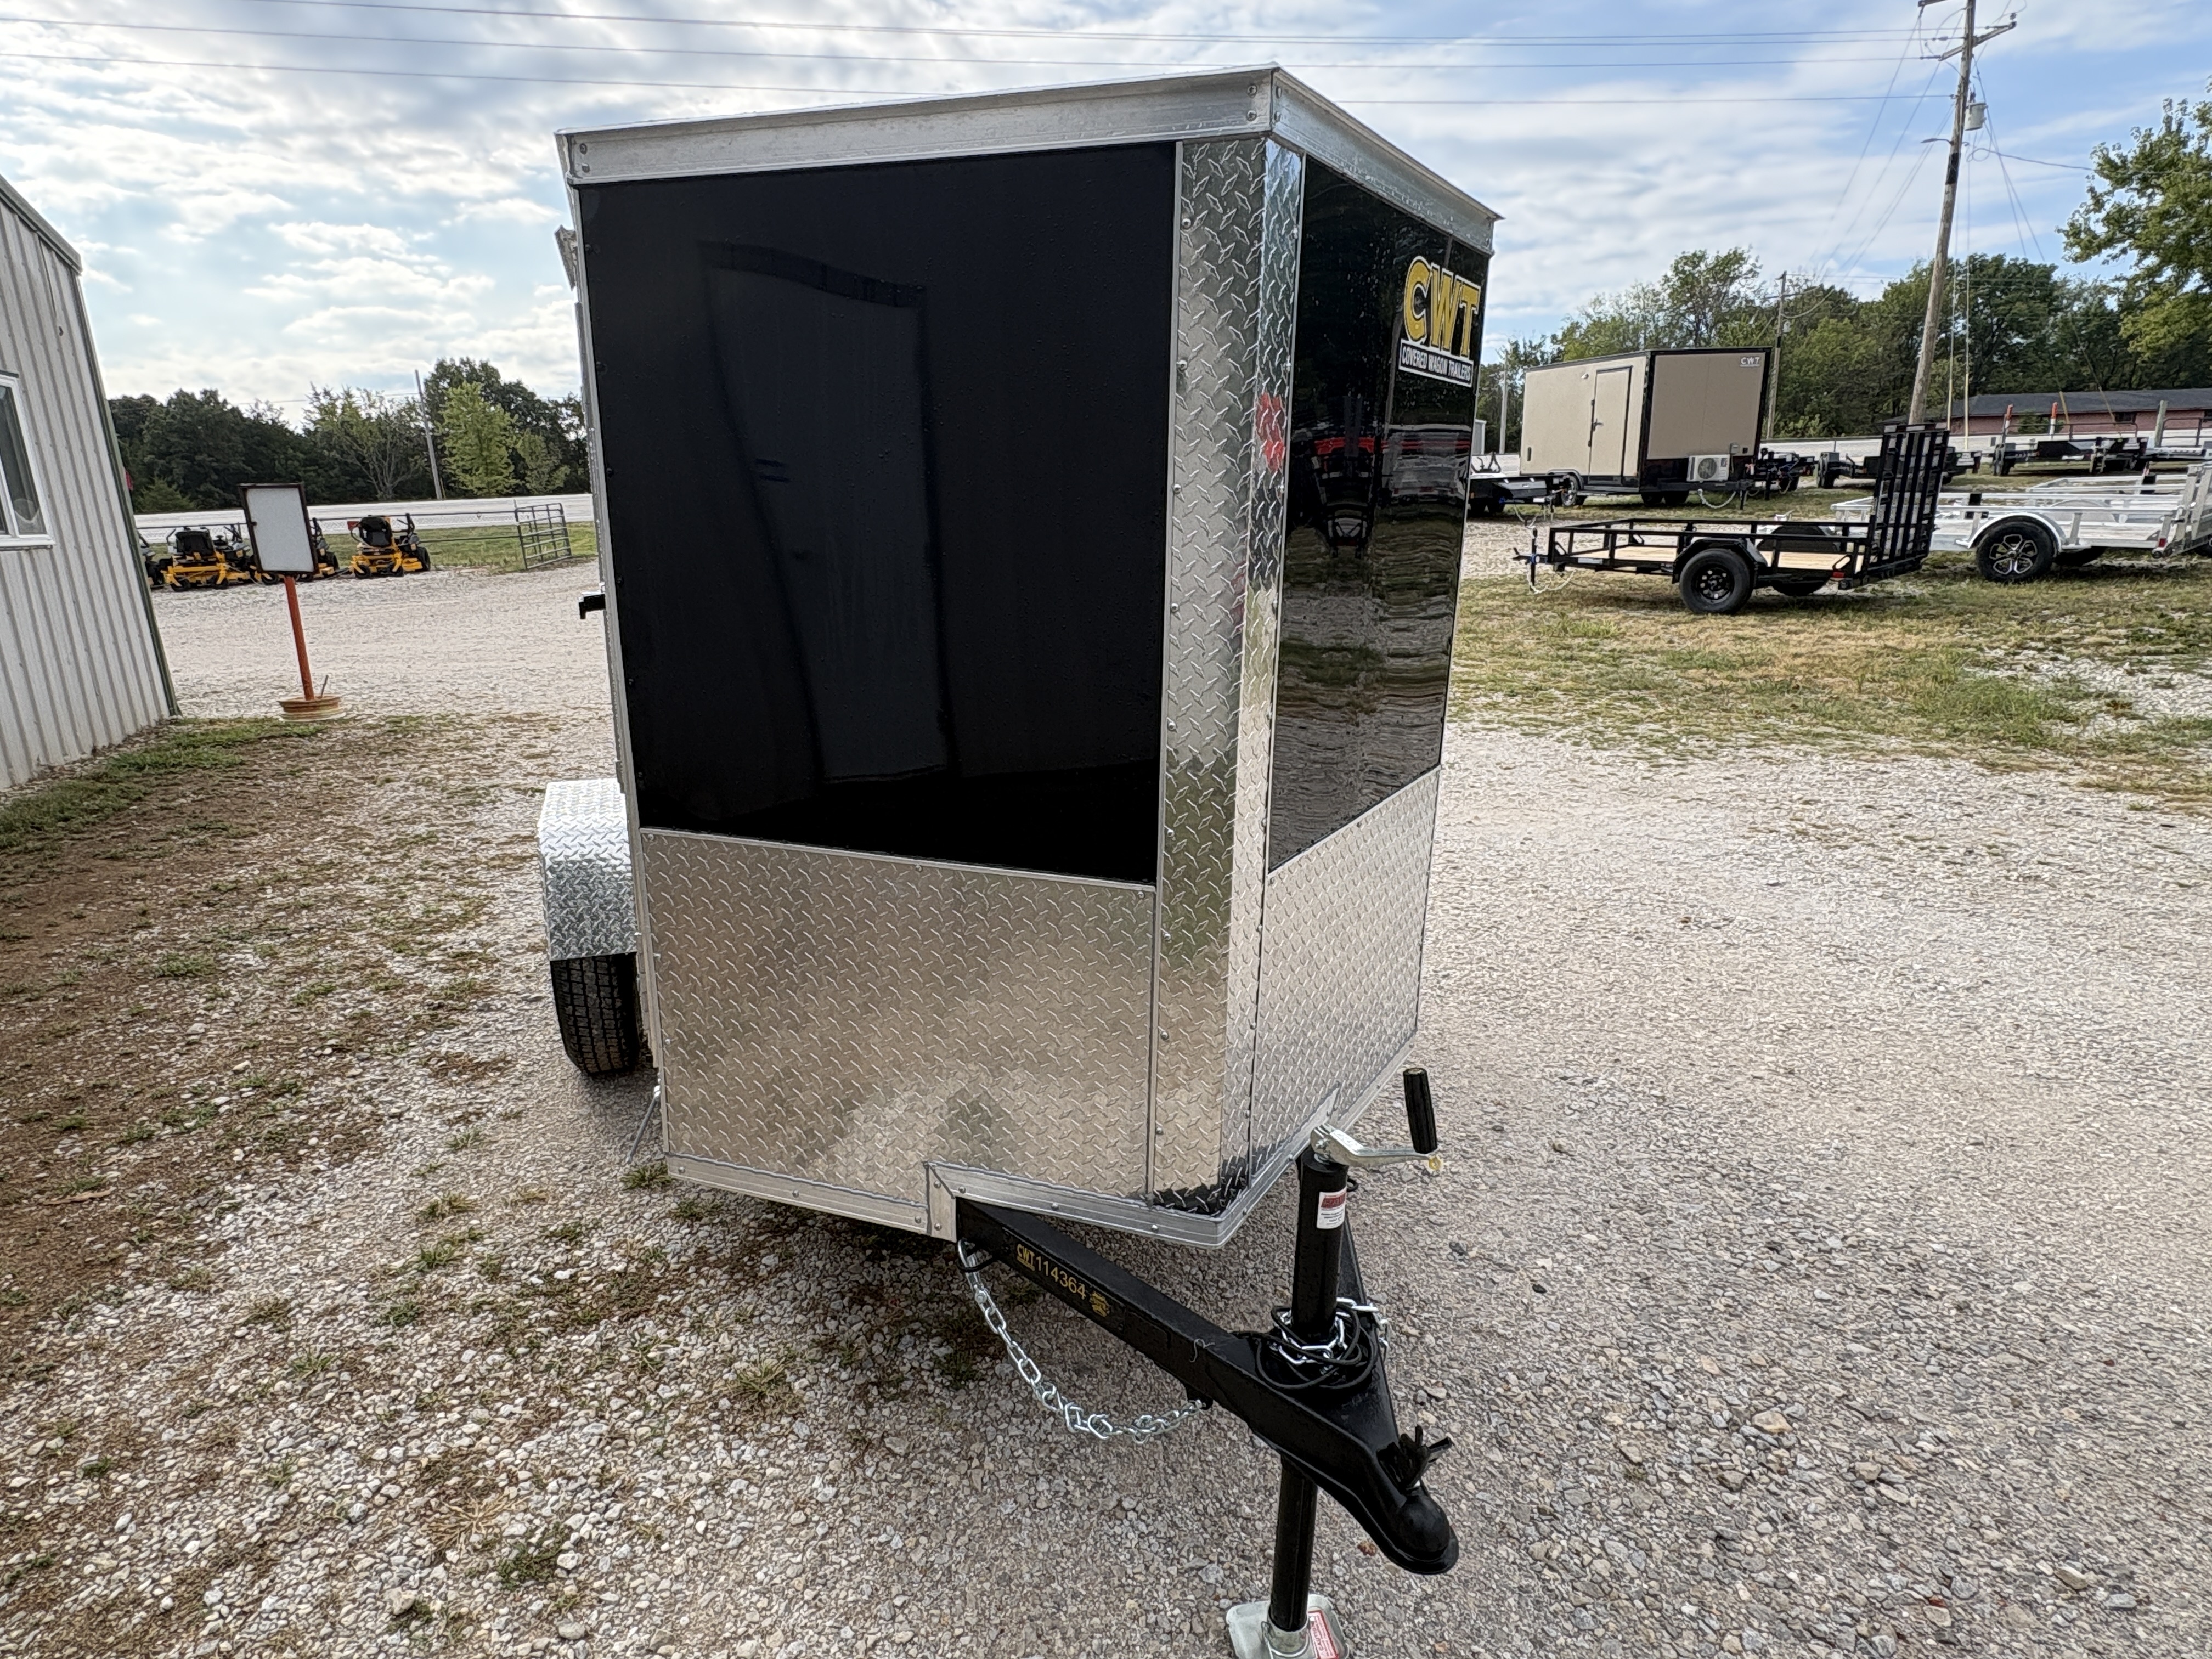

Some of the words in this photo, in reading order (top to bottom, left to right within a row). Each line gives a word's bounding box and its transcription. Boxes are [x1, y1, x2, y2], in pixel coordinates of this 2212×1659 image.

[1404, 257, 1480, 359] CWT
[1402, 346, 1427, 369] COVERED
[1428, 354, 1448, 375] WAGON
[1448, 359, 1471, 382] TRAILERS
